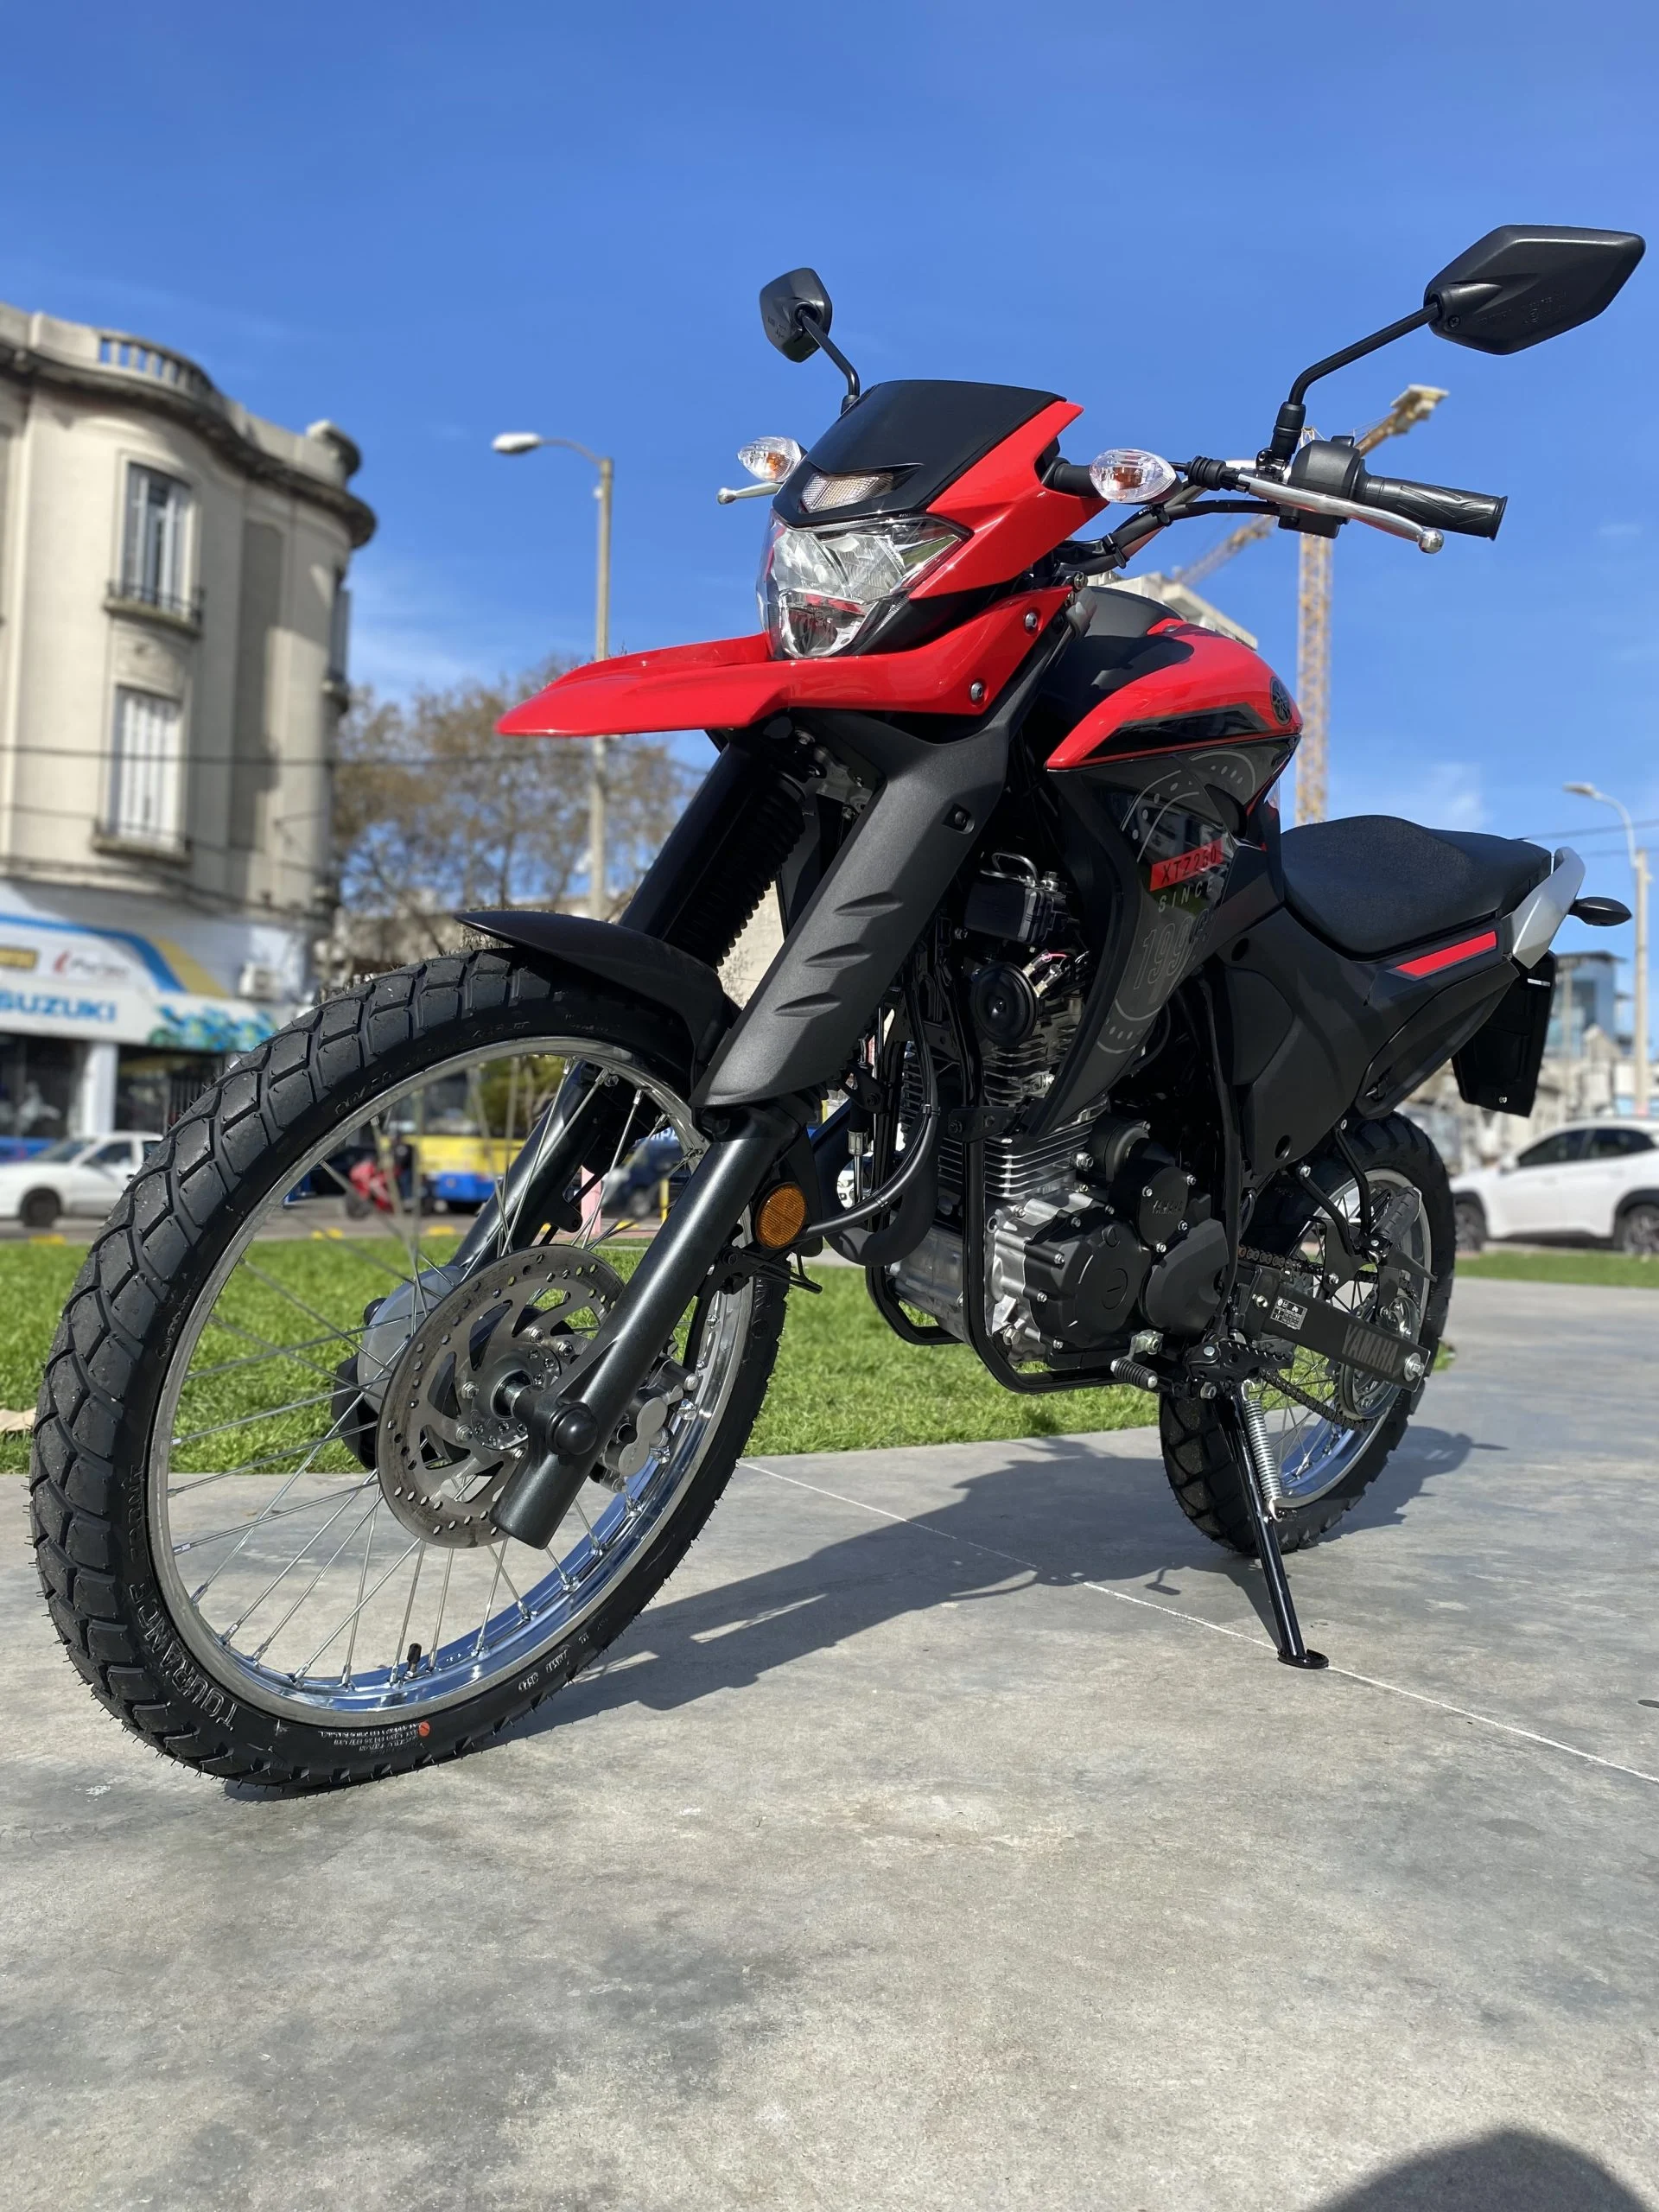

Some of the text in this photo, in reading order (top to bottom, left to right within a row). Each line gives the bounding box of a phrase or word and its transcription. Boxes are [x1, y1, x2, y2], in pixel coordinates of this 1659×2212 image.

[1158, 875, 1215, 912] SINCE
[0, 989, 116, 1021] SUZUKI
[1343, 1324, 1398, 1374] YAMAHA
[129, 1583, 240, 1732] TOURANCE
